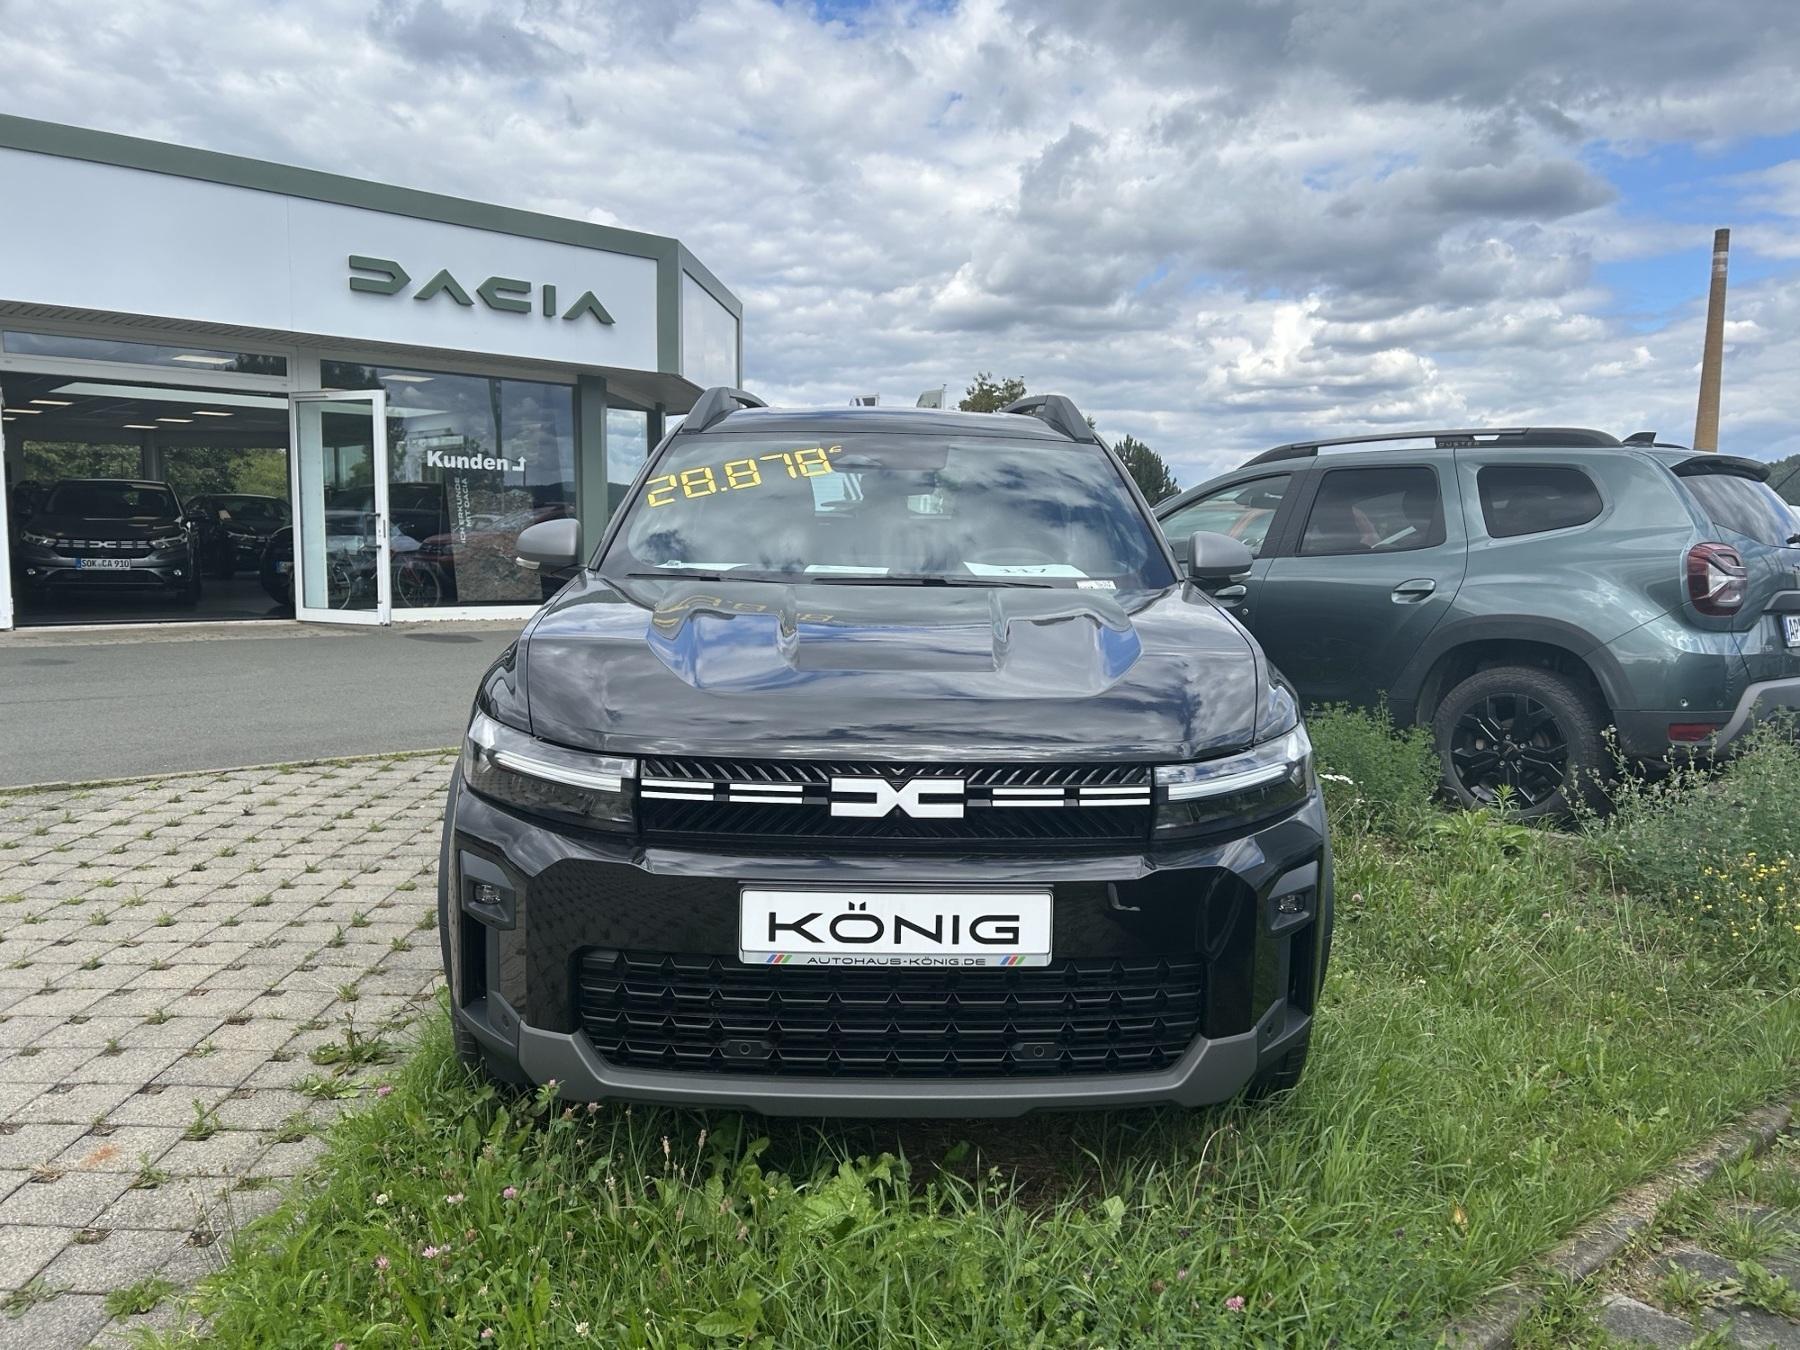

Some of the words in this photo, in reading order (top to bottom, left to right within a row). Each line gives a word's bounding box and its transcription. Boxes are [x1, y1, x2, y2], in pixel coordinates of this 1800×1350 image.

[349, 254, 616, 325] DACIA
[426, 450, 509, 471] Kunden
[461, 478, 470, 508] DACIA
[102, 559, 113, 568] CA
[114, 559, 130, 568] 910
[768, 901, 1020, 945] KÖNIG
[807, 956, 986, 966] AUTOHAUS-KÖNIG.DE
